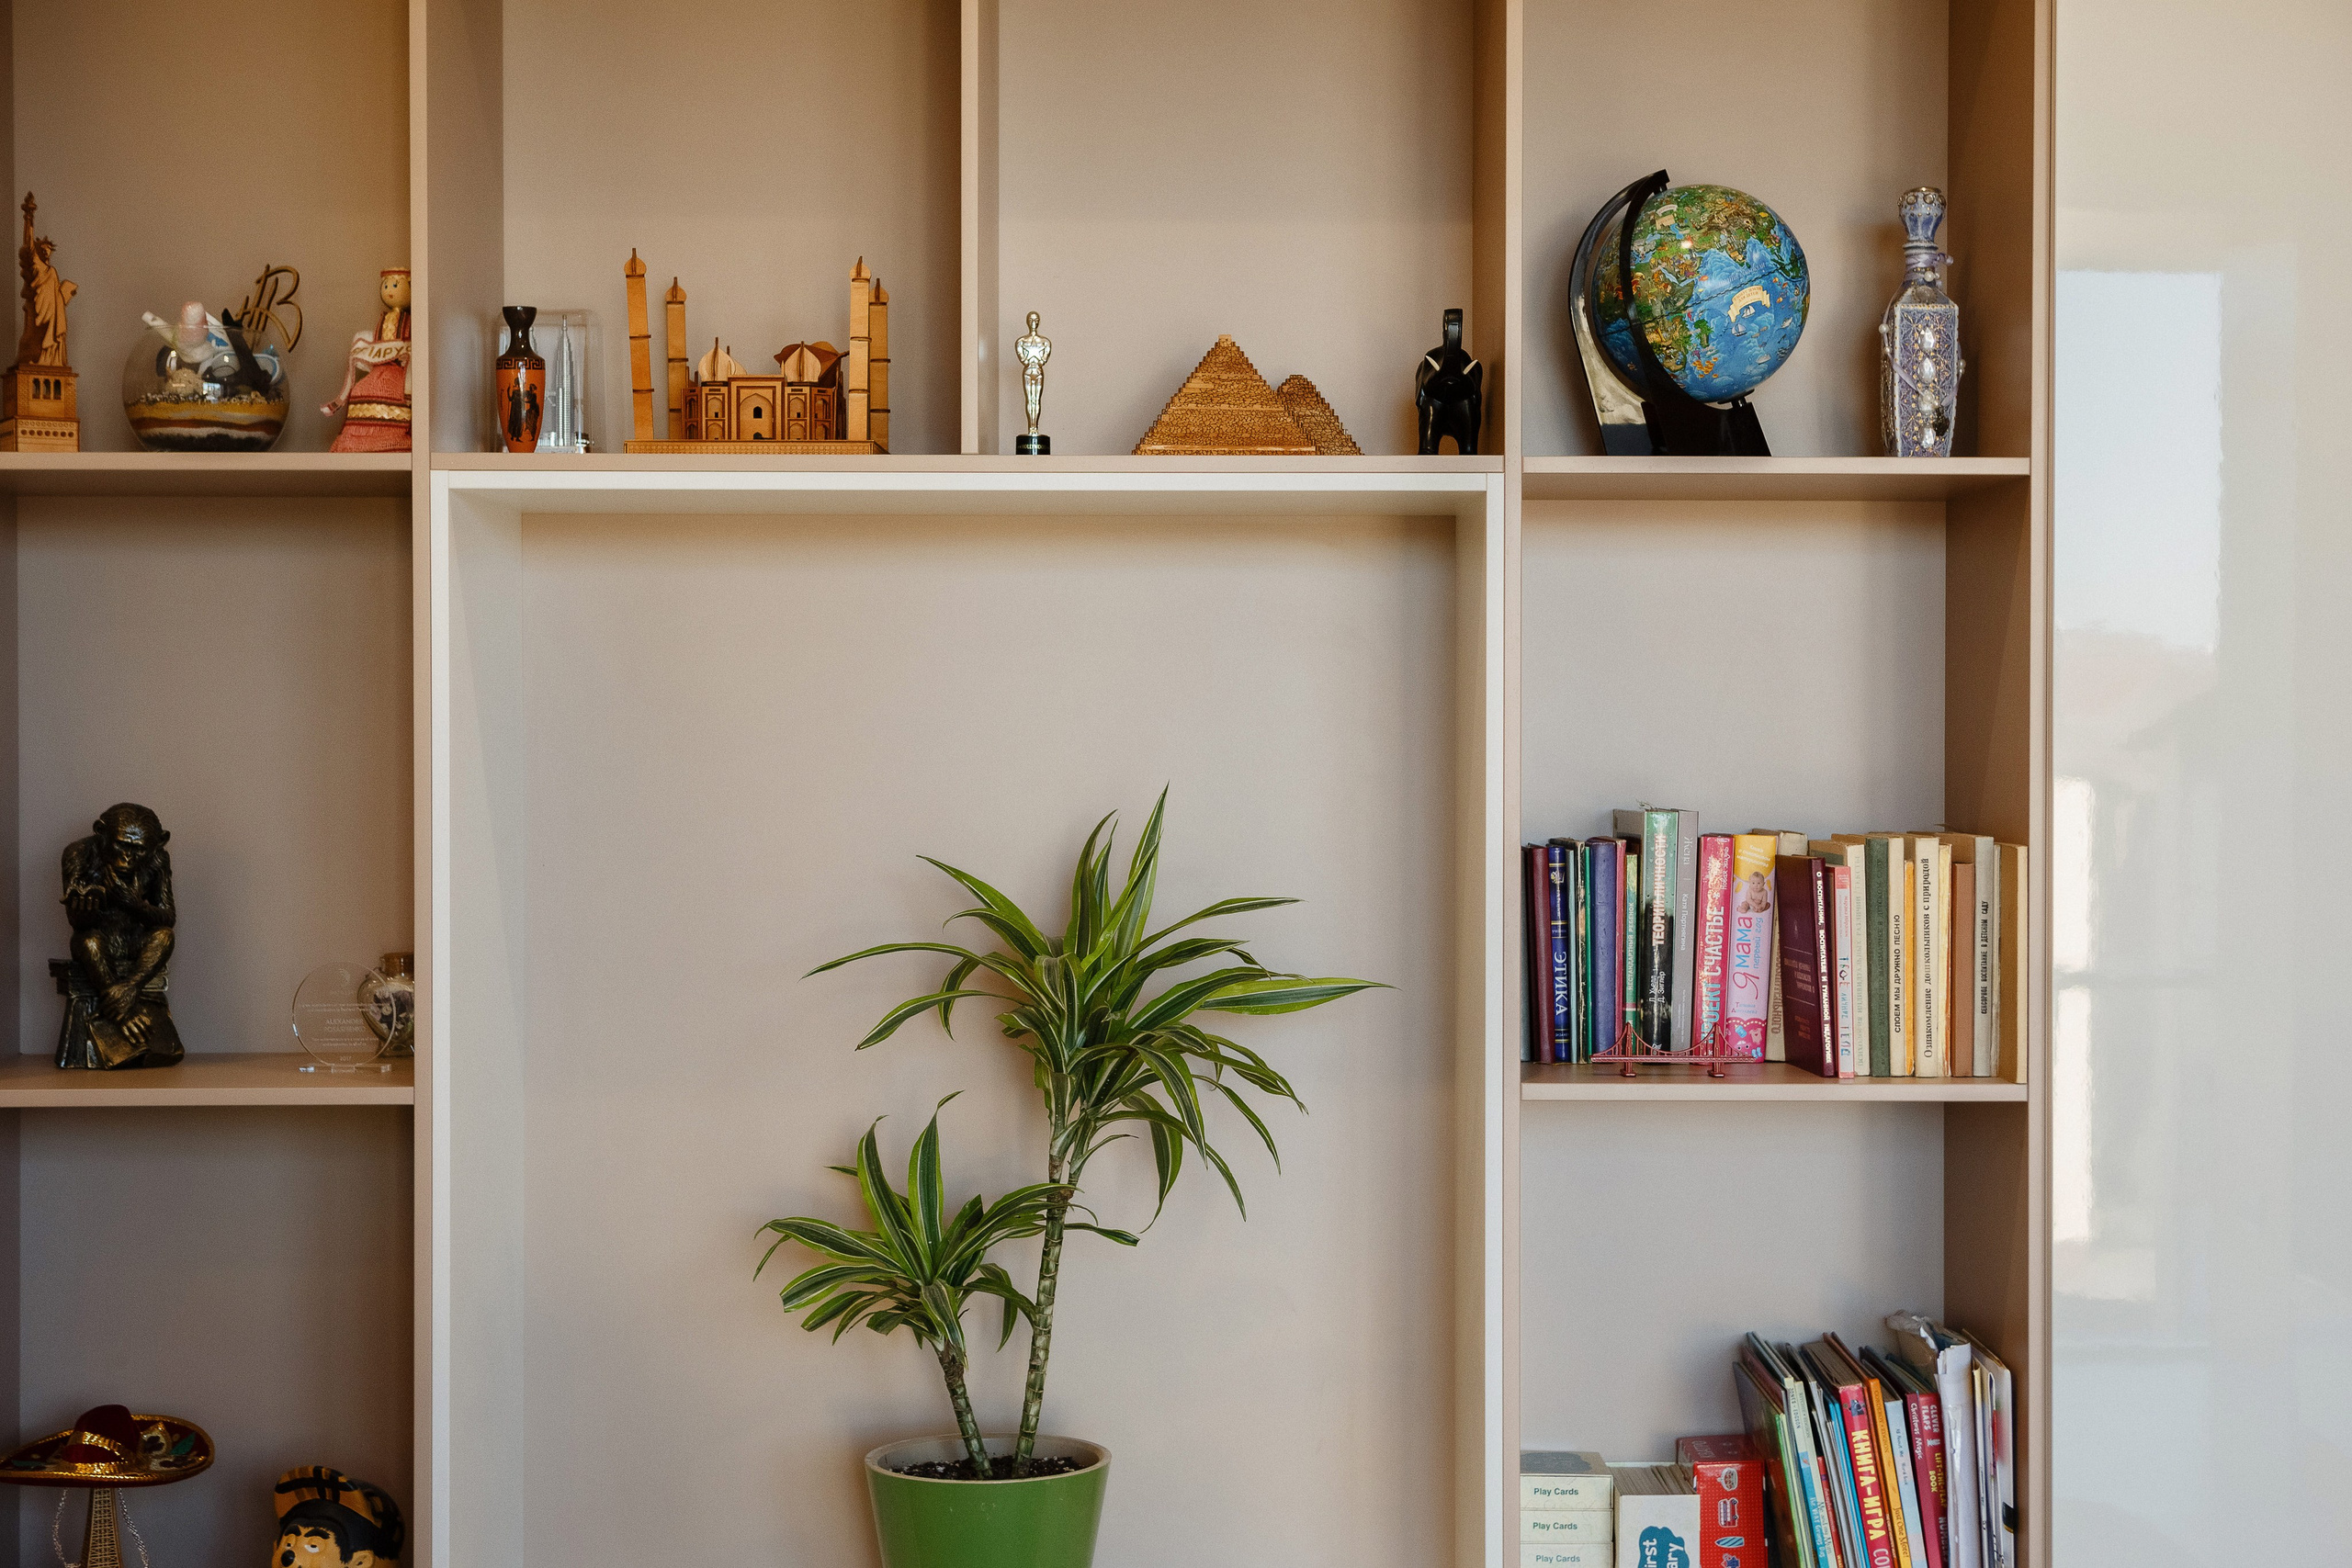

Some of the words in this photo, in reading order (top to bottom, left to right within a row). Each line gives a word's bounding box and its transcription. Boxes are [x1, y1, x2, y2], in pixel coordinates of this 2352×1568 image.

[1683, 836, 1692, 865] Жена
[1654, 833, 1668, 898] ЛИЧНОСТИ
[1921, 858, 1931, 903] природой
[1653, 899, 1666, 946] ТЕОРИИ
[1679, 909, 1689, 951] Портнягина
[1755, 917, 1764, 936] год
[1703, 907, 1724, 976] СЧАСТЬЕ
[1753, 937, 1761, 969] первый
[1923, 914, 1931, 985] дошкольников
[1554, 951, 1568, 1016] ЭТИКА
[1733, 972, 1759, 999] Я
[1894, 987, 1900, 1001] МЫ
[1701, 983, 1721, 1043] ПРОЕКТ
[1924, 988, 1932, 1058] Ознакомление
[1910, 1402, 1919, 1435] Christmas
[1921, 1405, 1931, 1430] FLAPS
[1929, 1404, 1939, 1433] CLEVER
[1914, 1437, 1924, 1460] Magic
[1533, 1487, 1552, 1496] Play
[1554, 1487, 1578, 1495] Cards
[1851, 1428, 1886, 1541] КНИГА-ИГРА
[1929, 1470, 1938, 1493] BOOK
[1935, 1452, 1947, 1507] LIFT-THE-FLAP
[1532, 1522, 1551, 1530] Play
[1893, 1506, 1903, 1522] Just
[1896, 1521, 1905, 1536] One
[1536, 1555, 1553, 1563] Play
[1643, 1539, 1657, 1568] irst
[1667, 1543, 1683, 1568] ary
[1898, 1535, 1909, 1558] More!
